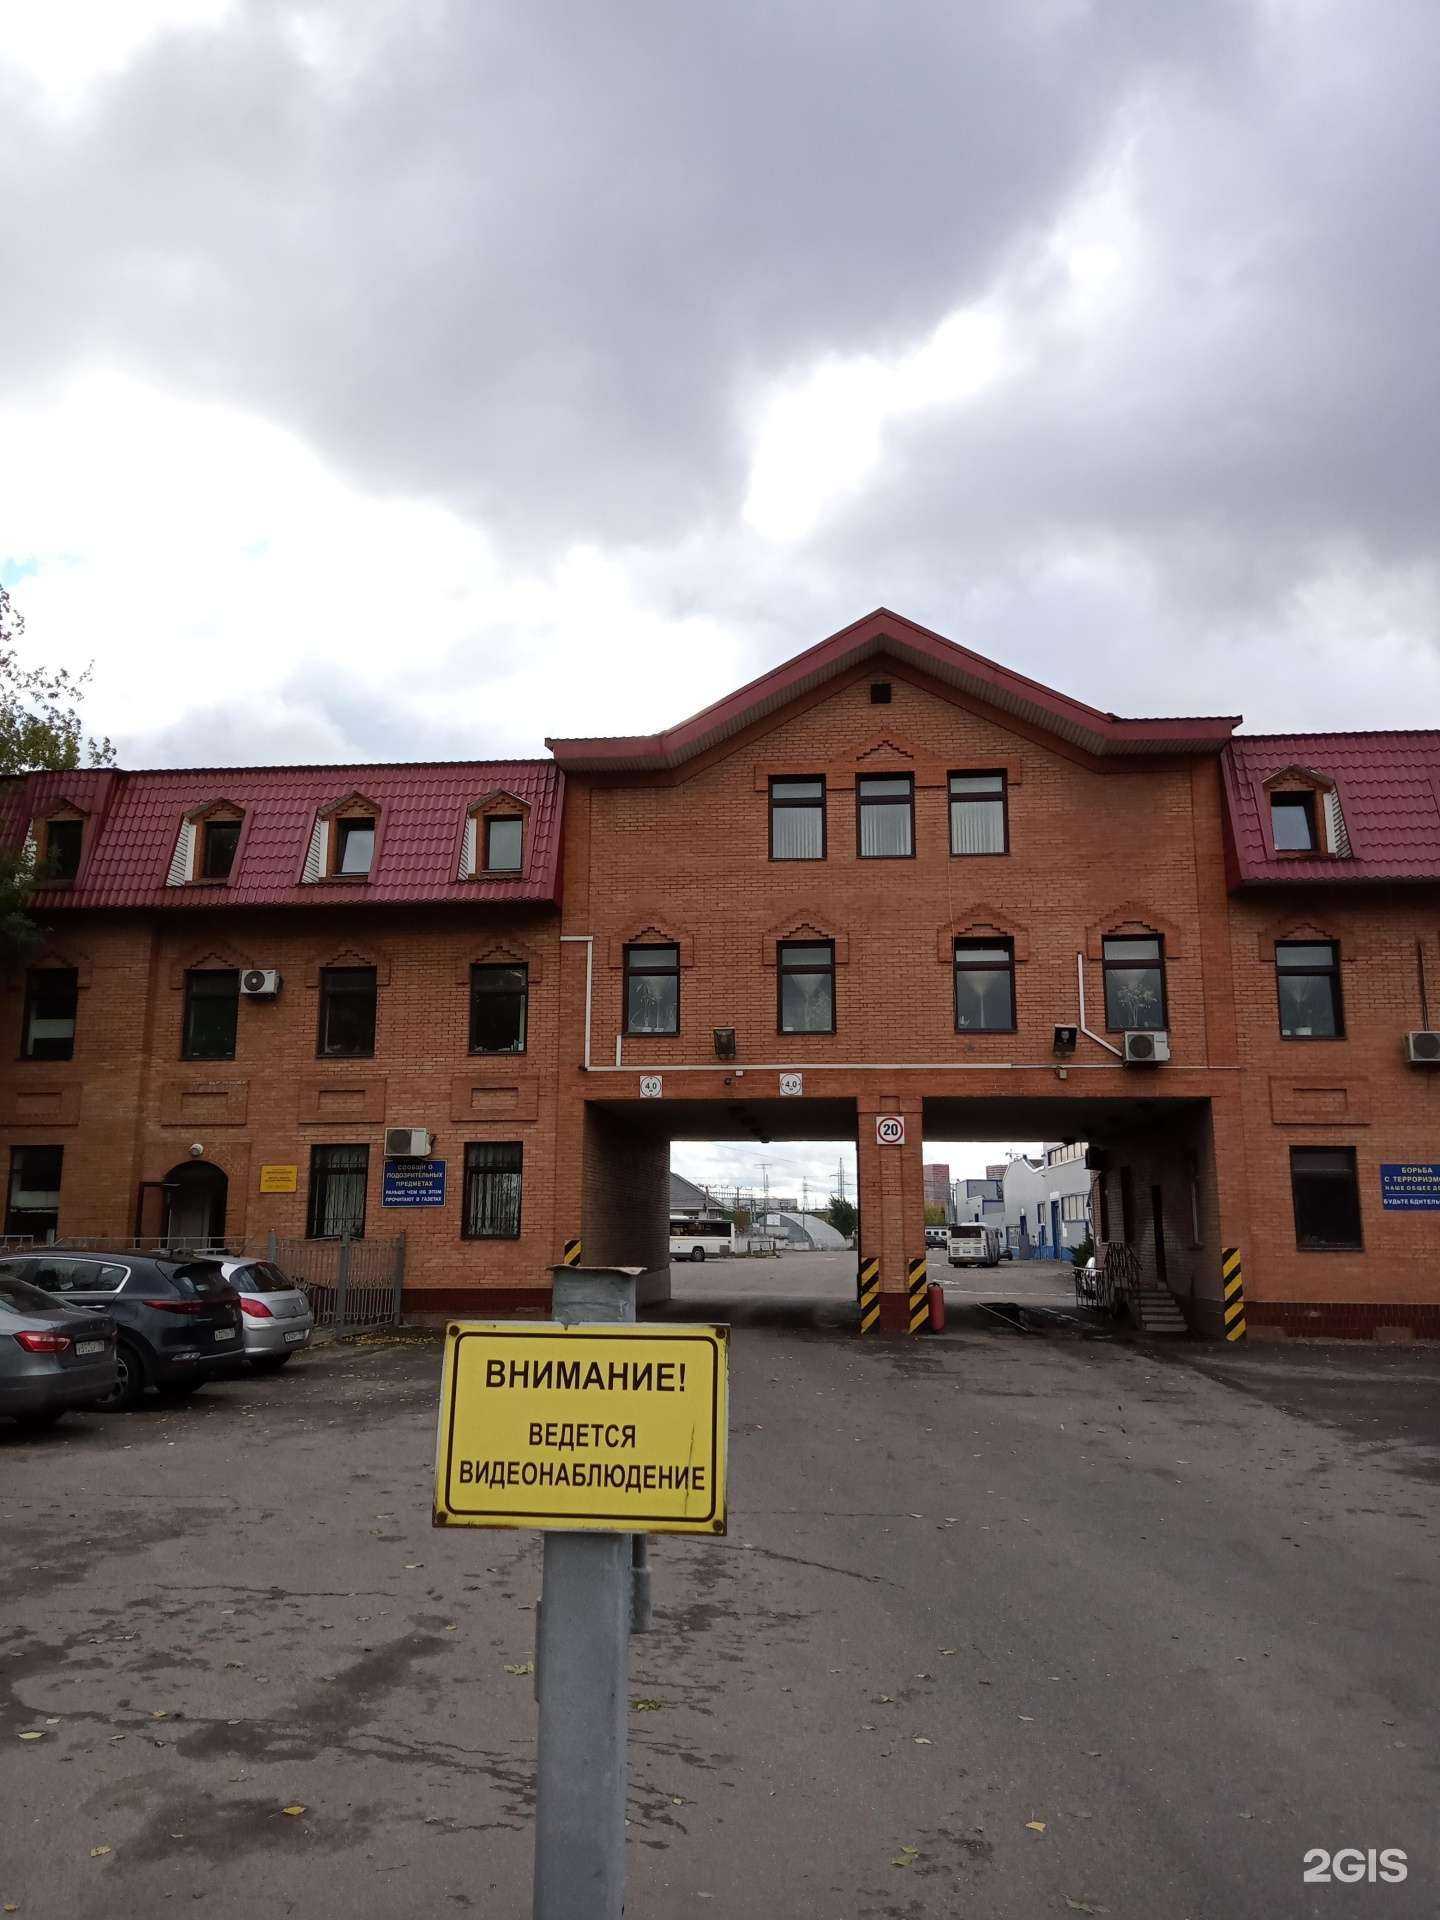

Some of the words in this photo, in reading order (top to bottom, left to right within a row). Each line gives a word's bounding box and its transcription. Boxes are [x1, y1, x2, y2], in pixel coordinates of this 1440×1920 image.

[883, 1123, 898, 1136] 20
[485, 1359, 686, 1392] ВНИМАНИЕ!
[528, 1422, 636, 1451] ВЕДЕТСЯ
[459, 1460, 705, 1493] ВИДЕОНАБЛЮДЕНИЕ
